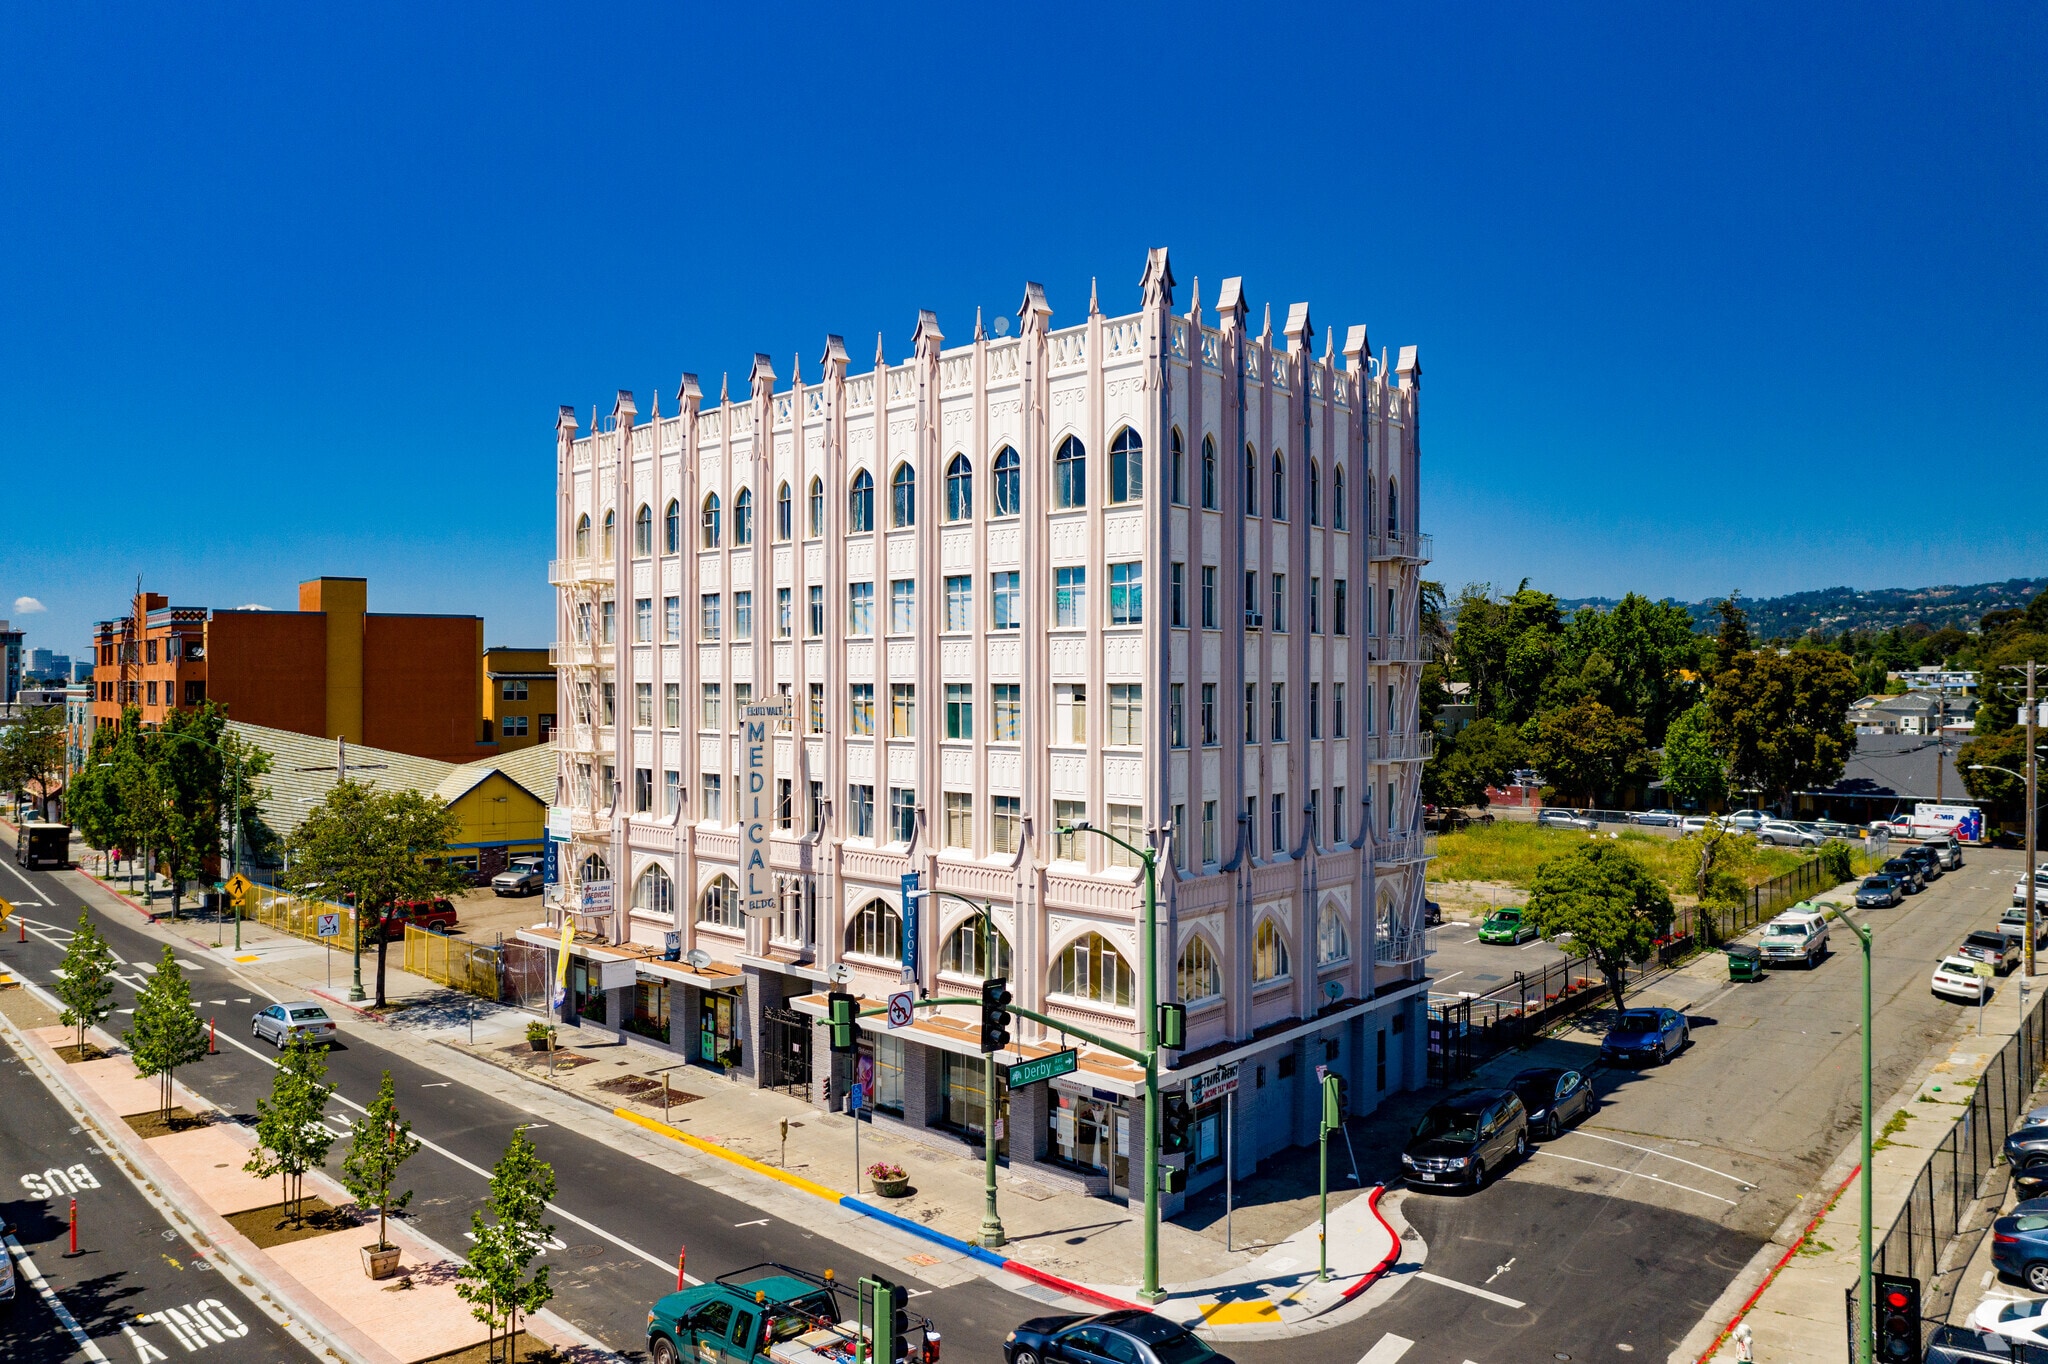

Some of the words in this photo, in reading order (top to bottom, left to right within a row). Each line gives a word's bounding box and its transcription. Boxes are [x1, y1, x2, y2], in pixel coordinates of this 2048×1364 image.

[747, 721, 766, 895] MEDICAL
[547, 847, 555, 879] LOMA
[906, 884, 915, 961] MEDICOS
[1024, 1062, 1052, 1079] Derby
[1060, 1083, 1082, 1091] INSURANCE
[1203, 1072, 1220, 1088] TRAVEL
[1221, 1065, 1239, 1081] AGENCY
[20, 1163, 102, 1200] BUS
[118, 1298, 249, 1364] ONLY
